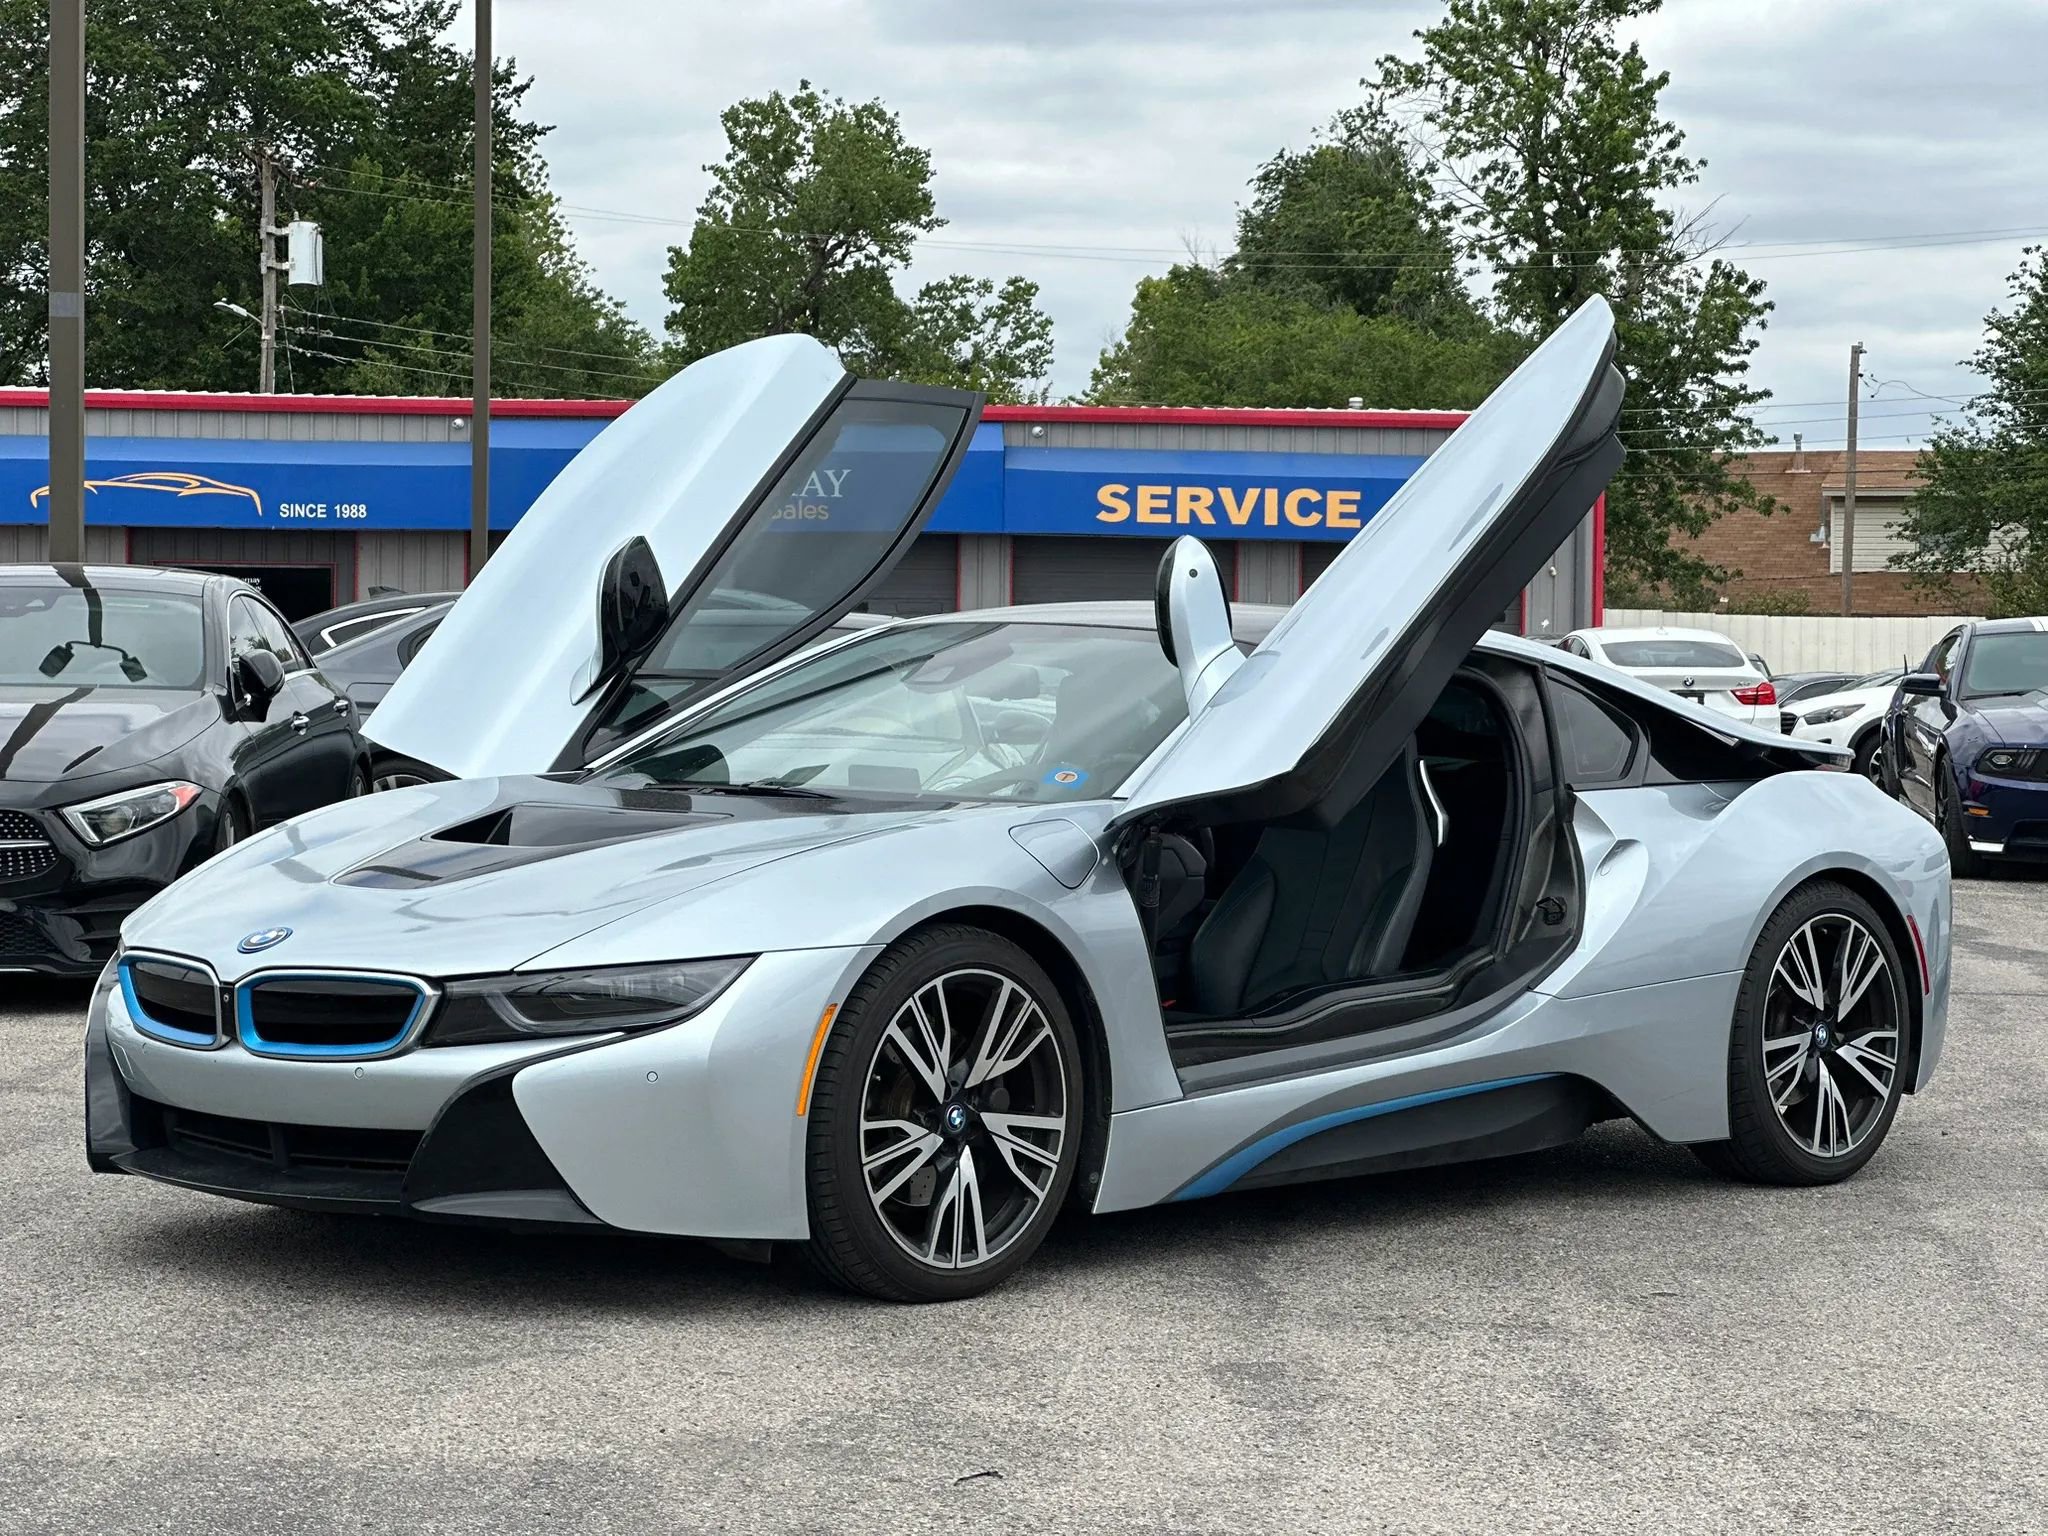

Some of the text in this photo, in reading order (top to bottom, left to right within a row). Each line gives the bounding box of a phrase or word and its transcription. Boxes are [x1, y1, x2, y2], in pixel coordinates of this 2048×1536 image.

[792, 469, 852, 498] AY
[279, 503, 367, 519] SINCE 1988
[1095, 483, 1362, 529] SERVICE
